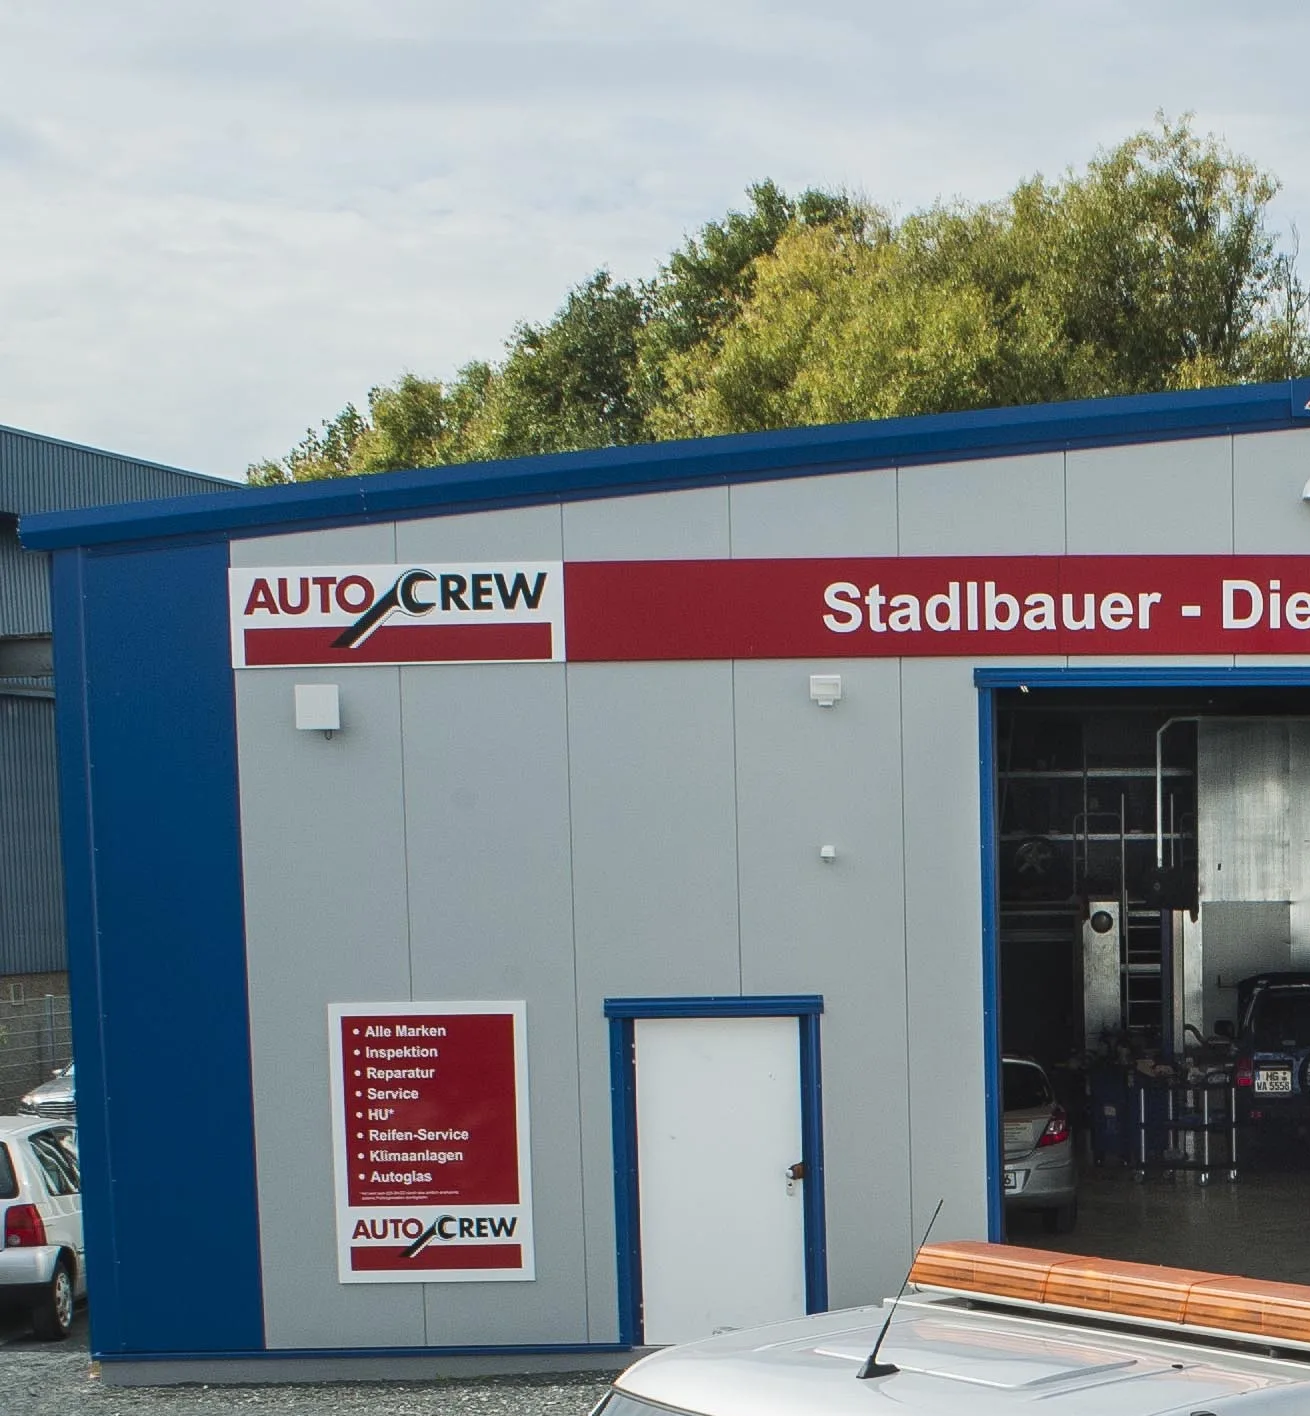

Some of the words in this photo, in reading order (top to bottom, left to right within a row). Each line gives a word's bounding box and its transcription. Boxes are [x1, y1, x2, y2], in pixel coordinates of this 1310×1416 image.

[244, 575, 375, 616] AUTO
[399, 568, 548, 616] CREW
[822, 582, 1162, 633] Stadlbauer
[1182, 606, 1201, 617] -
[365, 1025, 391, 1038] Alle
[395, 1025, 447, 1037] Marken
[365, 1046, 438, 1060] Inspektion
[367, 1067, 436, 1081] Reparatur
[367, 1087, 419, 1100] Service
[369, 1128, 469, 1142] Reifen-Service
[370, 1149, 463, 1164] Klimaanlagen
[370, 1170, 432, 1185] Autoglas
[351, 1218, 424, 1240] AUTO
[437, 1215, 518, 1240] CREW
